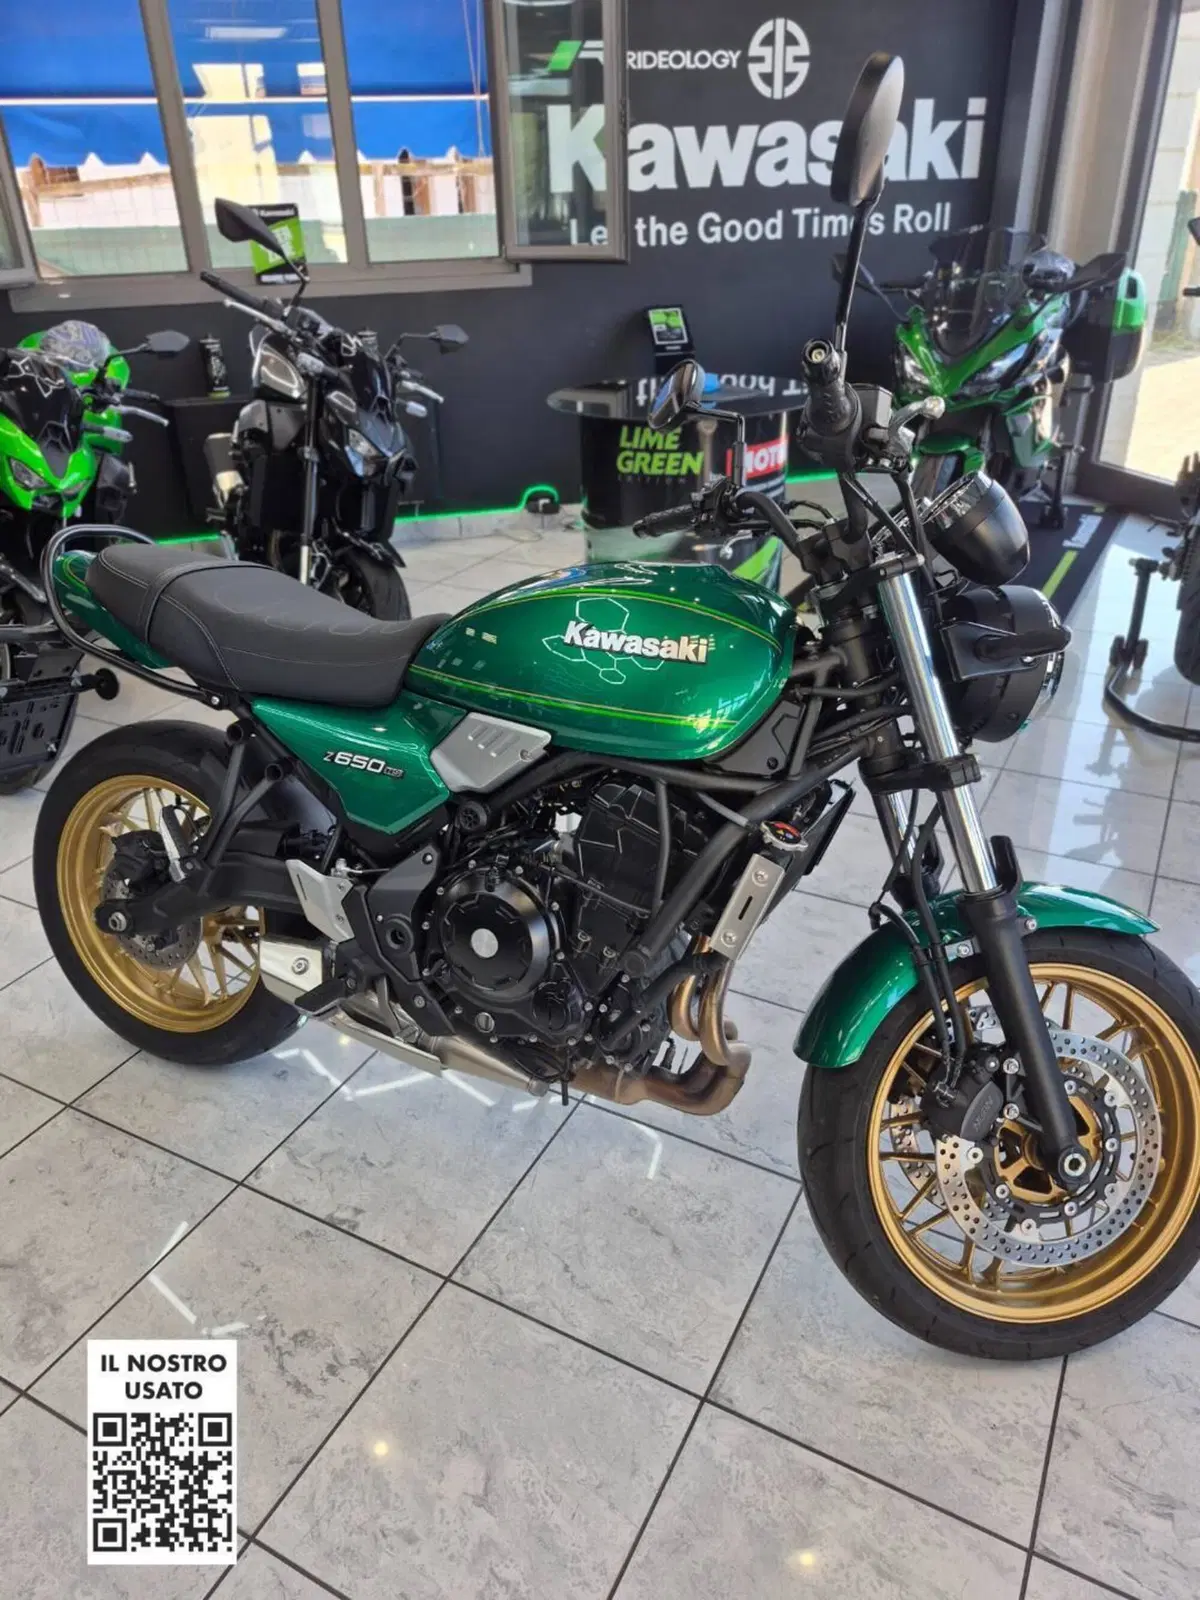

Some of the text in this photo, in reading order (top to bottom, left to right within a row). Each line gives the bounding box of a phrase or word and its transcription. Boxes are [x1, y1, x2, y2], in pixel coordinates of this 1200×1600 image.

[626, 49, 743, 70] RIDEOLOGY
[635, 215, 688, 247] the
[698, 211, 783, 243] Good
[792, 206, 886, 239] Tims
[893, 201, 951, 234] Roll
[619, 425, 682, 450] LIME
[616, 451, 705, 476] GREEN
[563, 620, 708, 664] Kawasaki
